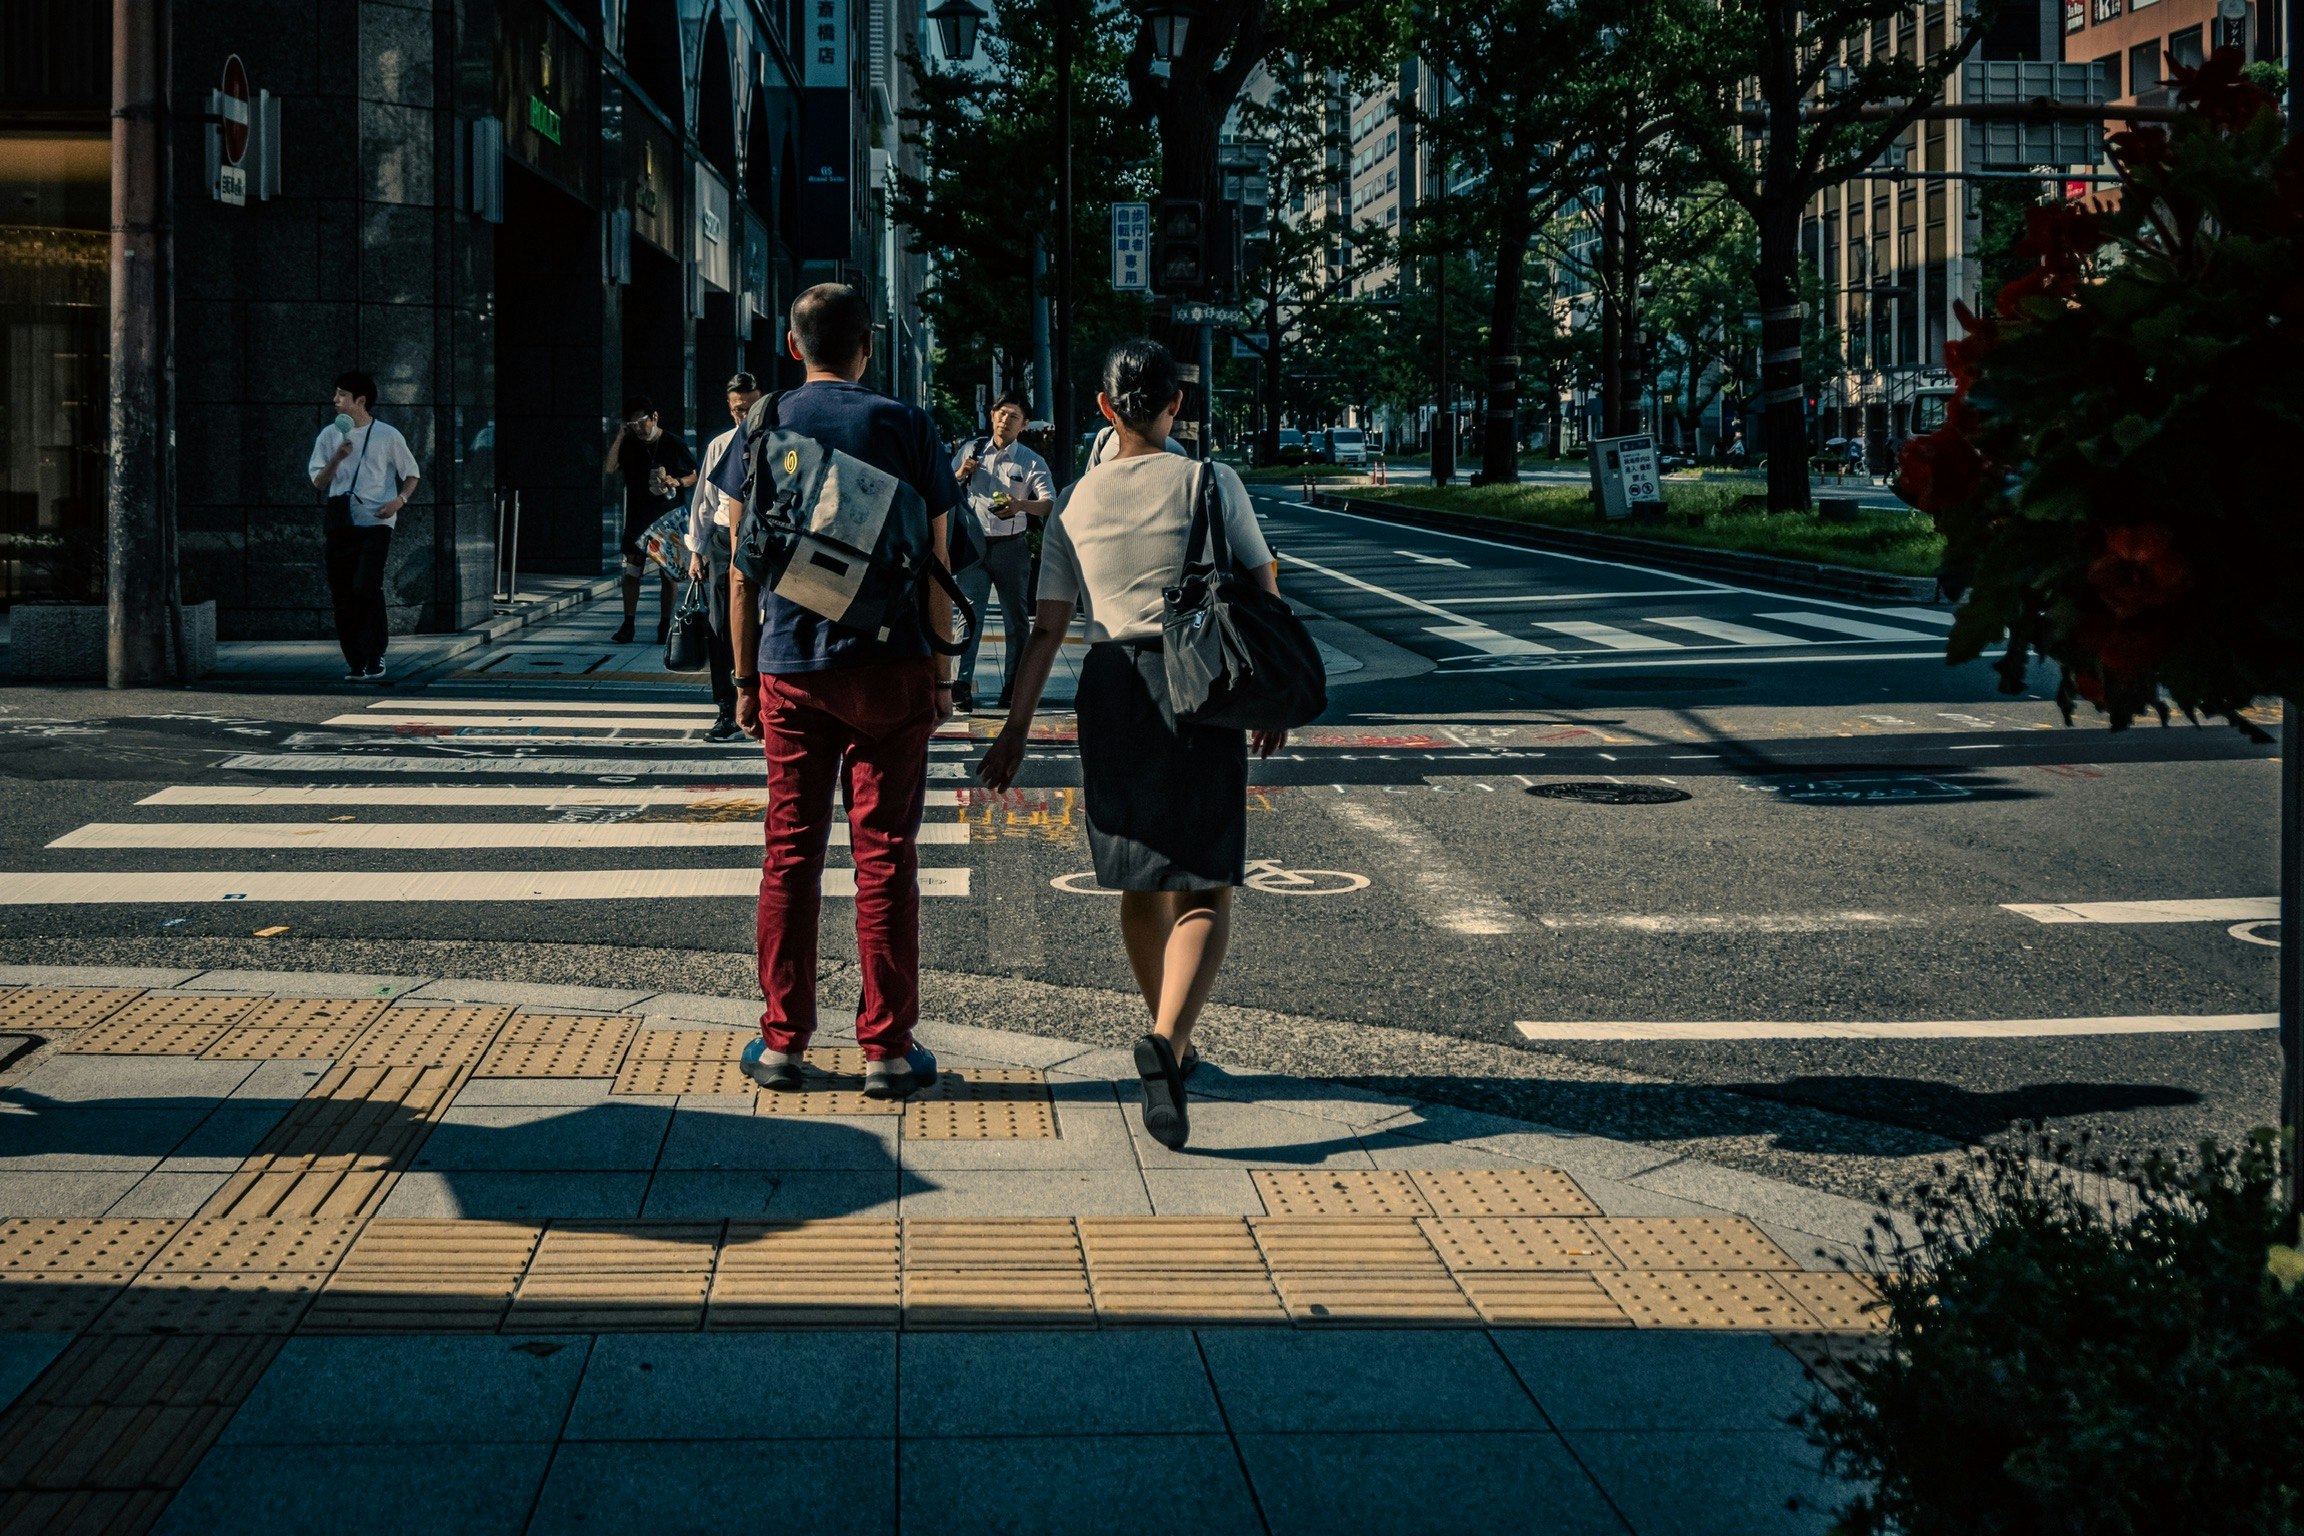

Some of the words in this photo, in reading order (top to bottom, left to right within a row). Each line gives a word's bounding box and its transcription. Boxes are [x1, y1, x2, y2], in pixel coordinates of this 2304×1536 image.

[1117, 209, 1130, 252] 自転車
[1131, 209, 1144, 252] 歩行者
[1124, 254, 1138, 284] 専用
